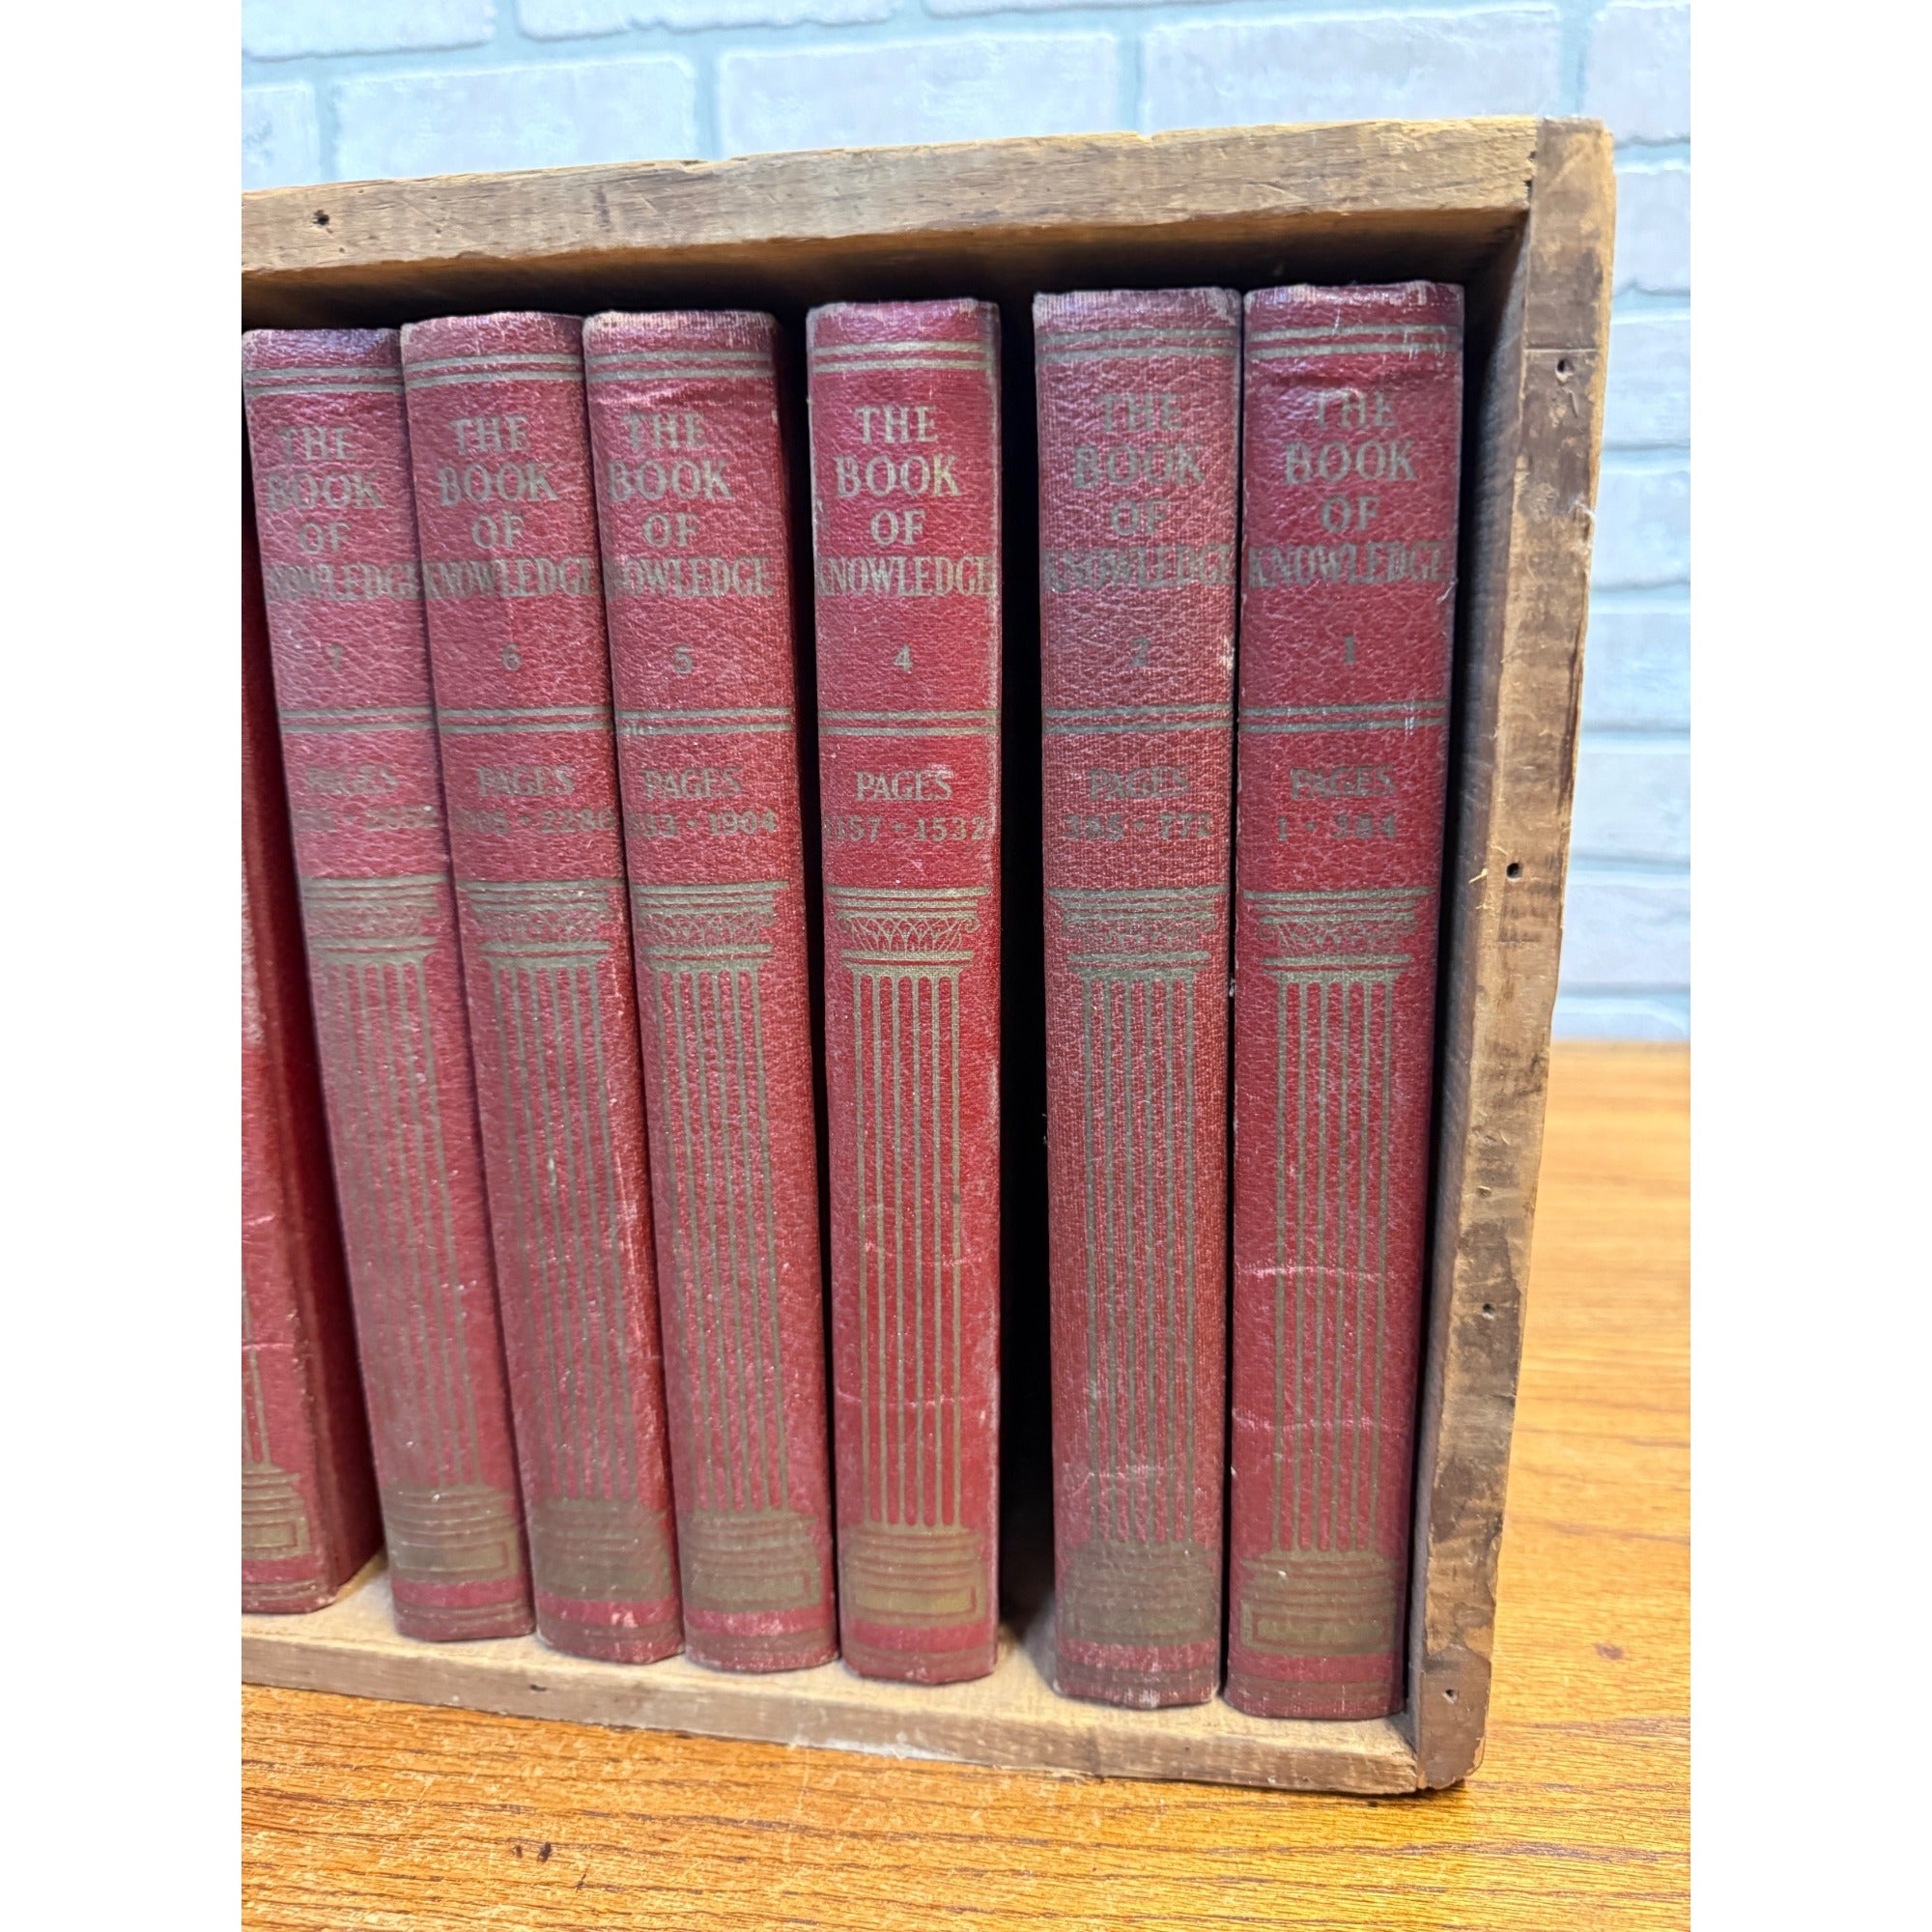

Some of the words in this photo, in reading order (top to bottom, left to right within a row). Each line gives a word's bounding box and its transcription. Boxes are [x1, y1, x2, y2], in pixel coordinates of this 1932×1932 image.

[855, 405, 939, 444] THE
[1094, 391, 1182, 433] THE
[1311, 388, 1395, 429] THE
[278, 423, 357, 463] THE
[448, 413, 531, 456] THE
[623, 411, 708, 451] THE
[608, 457, 734, 503] BOOK
[835, 453, 961, 498] BOOK
[1072, 440, 1205, 490] BOOK
[1283, 438, 1417, 486] BOOK
[266, 470, 386, 512] BOOK
[438, 460, 559, 507] BOOK
[470, 509, 524, 550] OF
[641, 511, 701, 549] OF
[870, 508, 925, 547] OF
[1110, 497, 1169, 537] OF
[1320, 494, 1380, 532] OF
[298, 521, 352, 554] OF
[1248, 540, 1446, 589] KNOWLEDGE
[327, 644, 345, 672] 7
[500, 642, 523, 672] 6
[672, 644, 695, 675] 5
[893, 643, 914, 673] 4
[1128, 636, 1151, 668] 2
[1341, 634, 1355, 666] 1
[476, 764, 575, 797] PAGES
[640, 766, 743, 800] PAGES
[854, 771, 954, 802] PAGES
[1088, 765, 1190, 802] PAGES
[1290, 765, 1397, 801] PAGES
[707, 809, 779, 837] 1904
[915, 816, 987, 841] 1532
[1064, 813, 1125, 841] 385
[1277, 817, 1289, 841] 1
